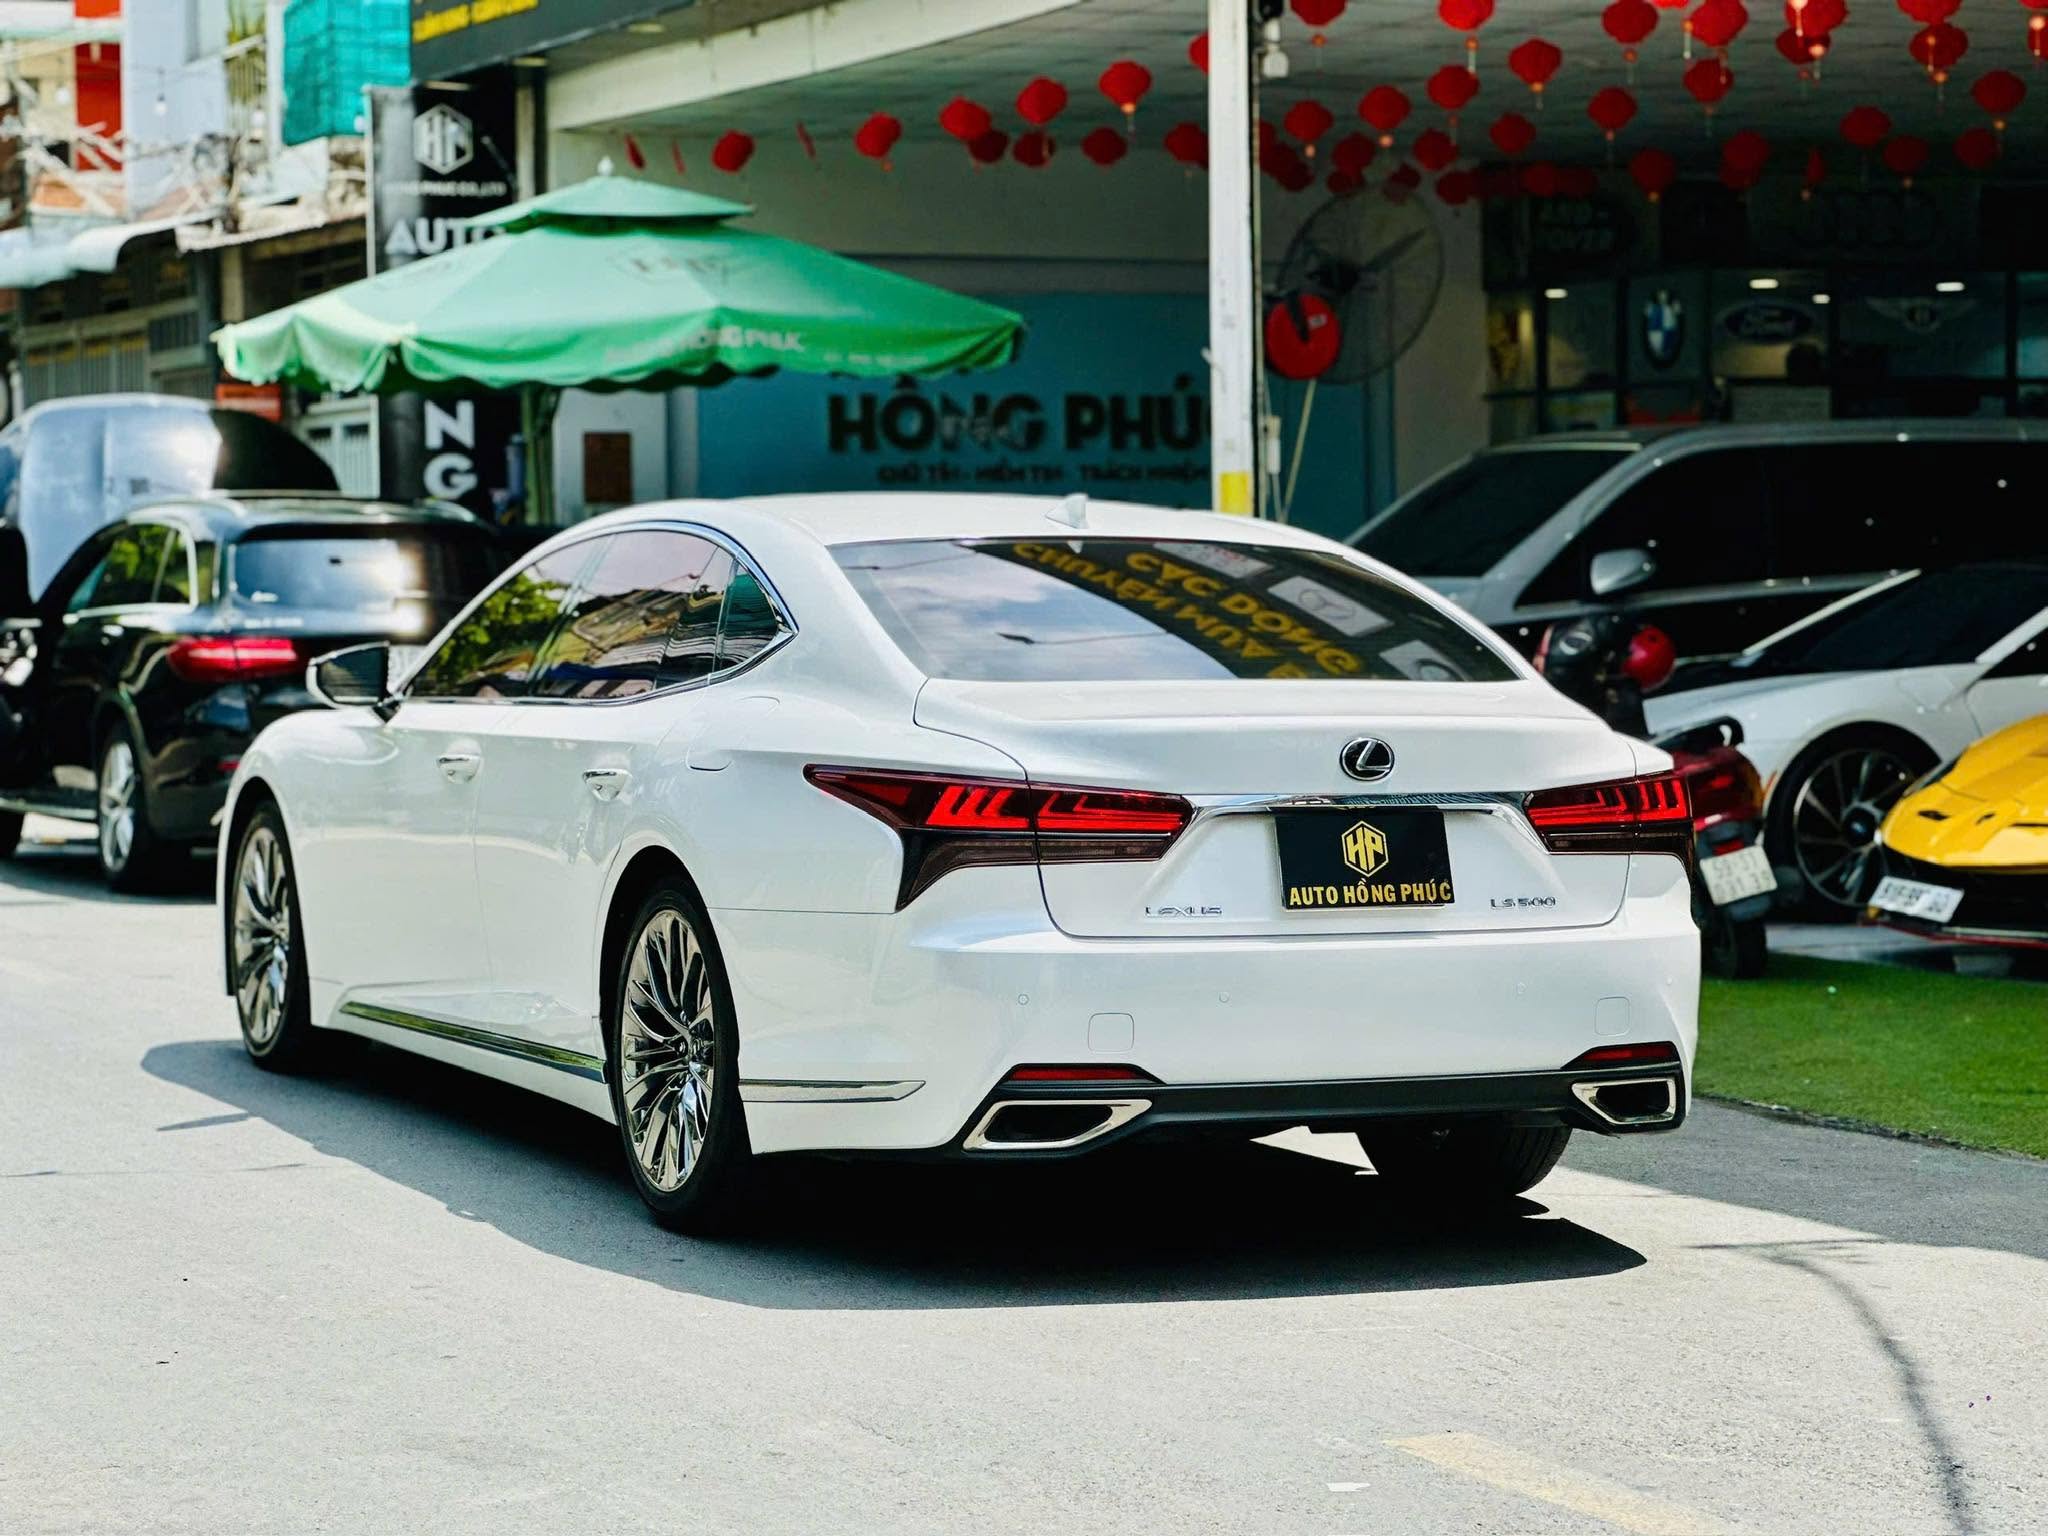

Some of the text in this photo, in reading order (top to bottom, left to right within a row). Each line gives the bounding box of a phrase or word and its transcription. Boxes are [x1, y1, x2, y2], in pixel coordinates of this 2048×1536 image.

[1064, 373, 1211, 452] PHÚ
[1345, 825, 1384, 872] HP
[1289, 878, 1452, 907] AUTO HỒNG PHÚC
[1145, 906, 1222, 918] LEXUS
